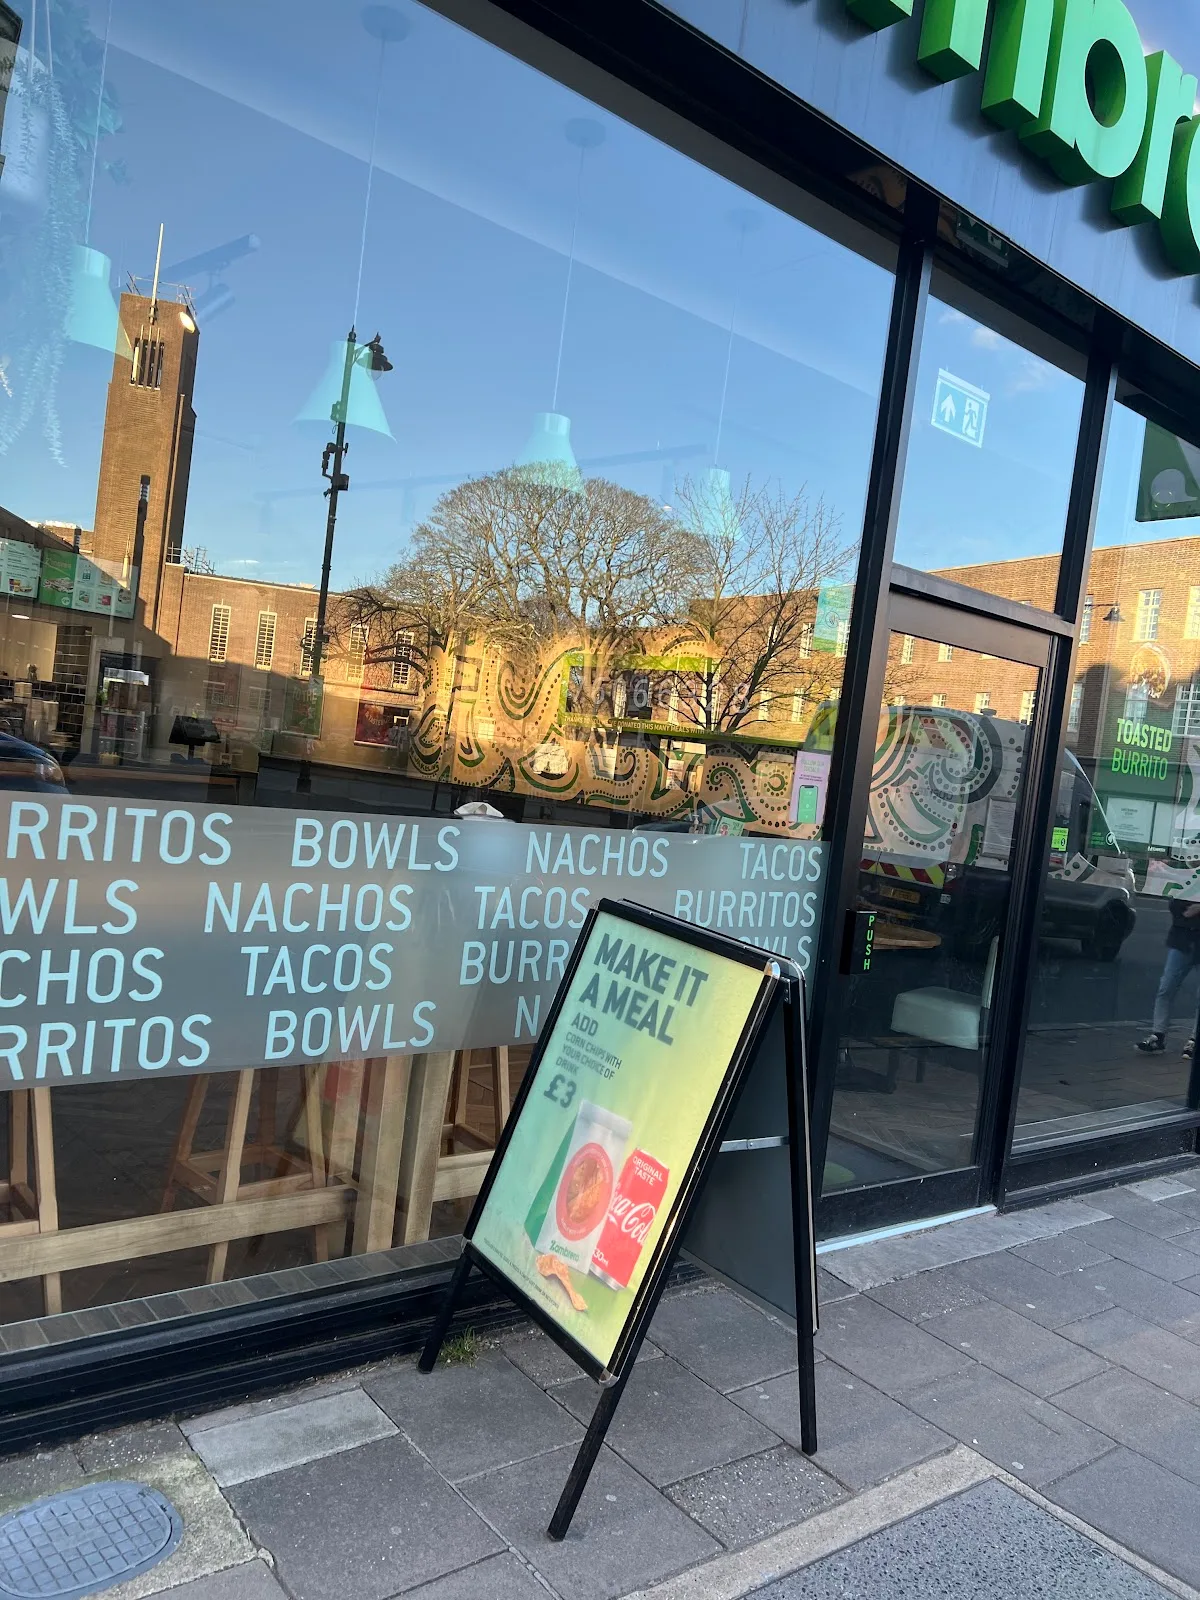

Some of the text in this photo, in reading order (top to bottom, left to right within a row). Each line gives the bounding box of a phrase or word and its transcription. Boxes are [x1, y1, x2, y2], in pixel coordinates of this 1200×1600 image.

[618, 720, 641, 730] DONATED
[641, 722, 653, 730] THIS
[654, 723, 670, 732] MANY
[671, 724, 689, 734] MEALS
[1117, 717, 1172, 752] TOASTED
[1111, 748, 1168, 781] BURRITO
[7, 801, 823, 882] RRITOS BOWLS NACHOS TACOS
[0, 877, 818, 935] WLS NACHOS TACOS BURRITOS
[863, 915, 875, 970] PUSH
[0, 947, 165, 1008] CHOS
[240, 942, 394, 997] TACOS
[459, 938, 578, 986] BURR
[593, 932, 709, 1007] MAKE IT
[571, 1012, 599, 1037] ADD
[578, 973, 600, 1009] A
[601, 980, 675, 1046] MEAL
[0, 1000, 437, 1081] RRITOS BOWLS
[565, 1031, 622, 1070] CORN CHIPS WITH
[555, 1056, 579, 1076] DRINK
[562, 1043, 615, 1080] YOUR CHOICE OF
[543, 1073, 577, 1109] £3
[632, 1155, 663, 1182] ORIGINAL
[634, 1167, 656, 1186] TASTE
[549, 1240, 580, 1262] Zambrero
[592, 1248, 609, 1268] 30ml
